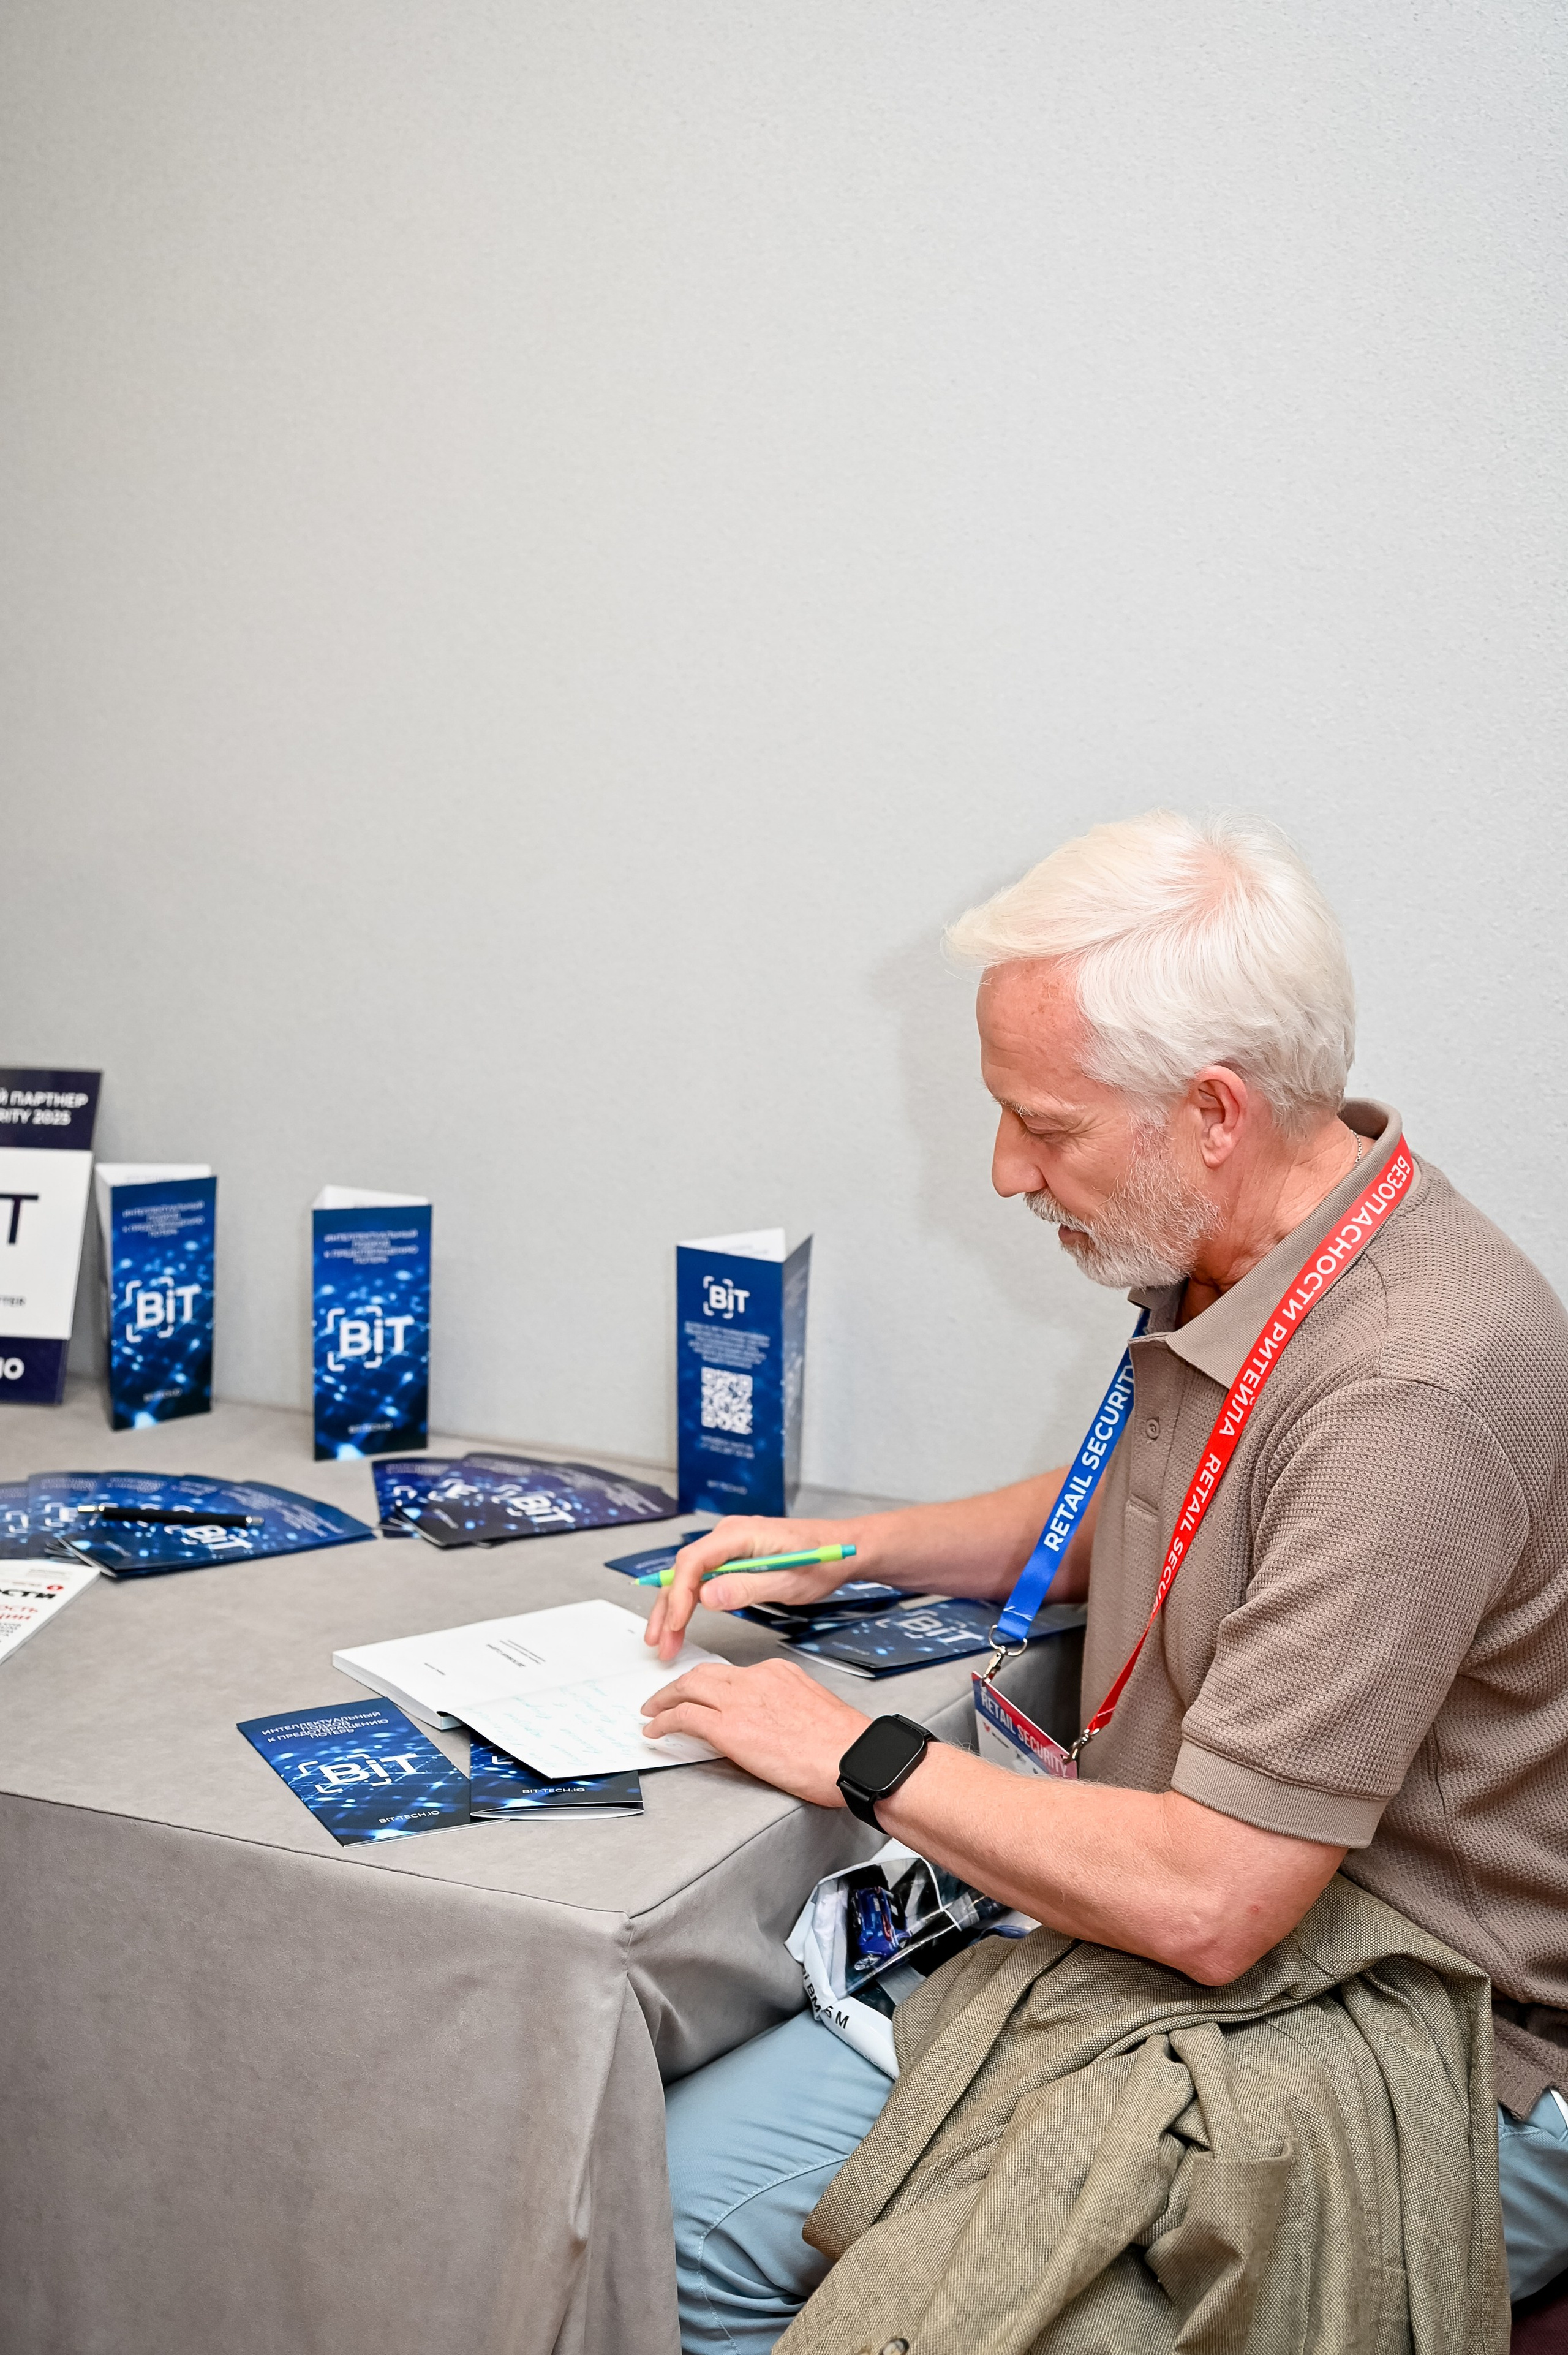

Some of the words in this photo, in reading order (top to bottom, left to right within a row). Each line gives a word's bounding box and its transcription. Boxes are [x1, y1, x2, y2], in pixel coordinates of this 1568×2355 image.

[10, 1091, 89, 1108] ПАРТНЕР
[1282, 1155, 1411, 1322] БЕЗОПАСНОСТИ
[1219, 1321, 1287, 1436] РИТЕЙЛА
[1180, 1453, 1221, 1531] RETAIL
[1043, 1474, 1093, 1552] RETAIL
[0, 1589, 56, 1599] СТИ
[262, 1711, 381, 1736] ИНТЕЛЛЕКТУАЛЬНЫЙ
[277, 1718, 389, 1741] ПРЕДОТВРАЩЕНИЮ
[309, 1728, 355, 1739] ПОТЕРЬ
[981, 1691, 1016, 1735] RETAIL
[1017, 1723, 1068, 1777] SECURITY
[378, 1810, 440, 1823] BIT-TECH.IO
[835, 2011, 850, 2029] M
